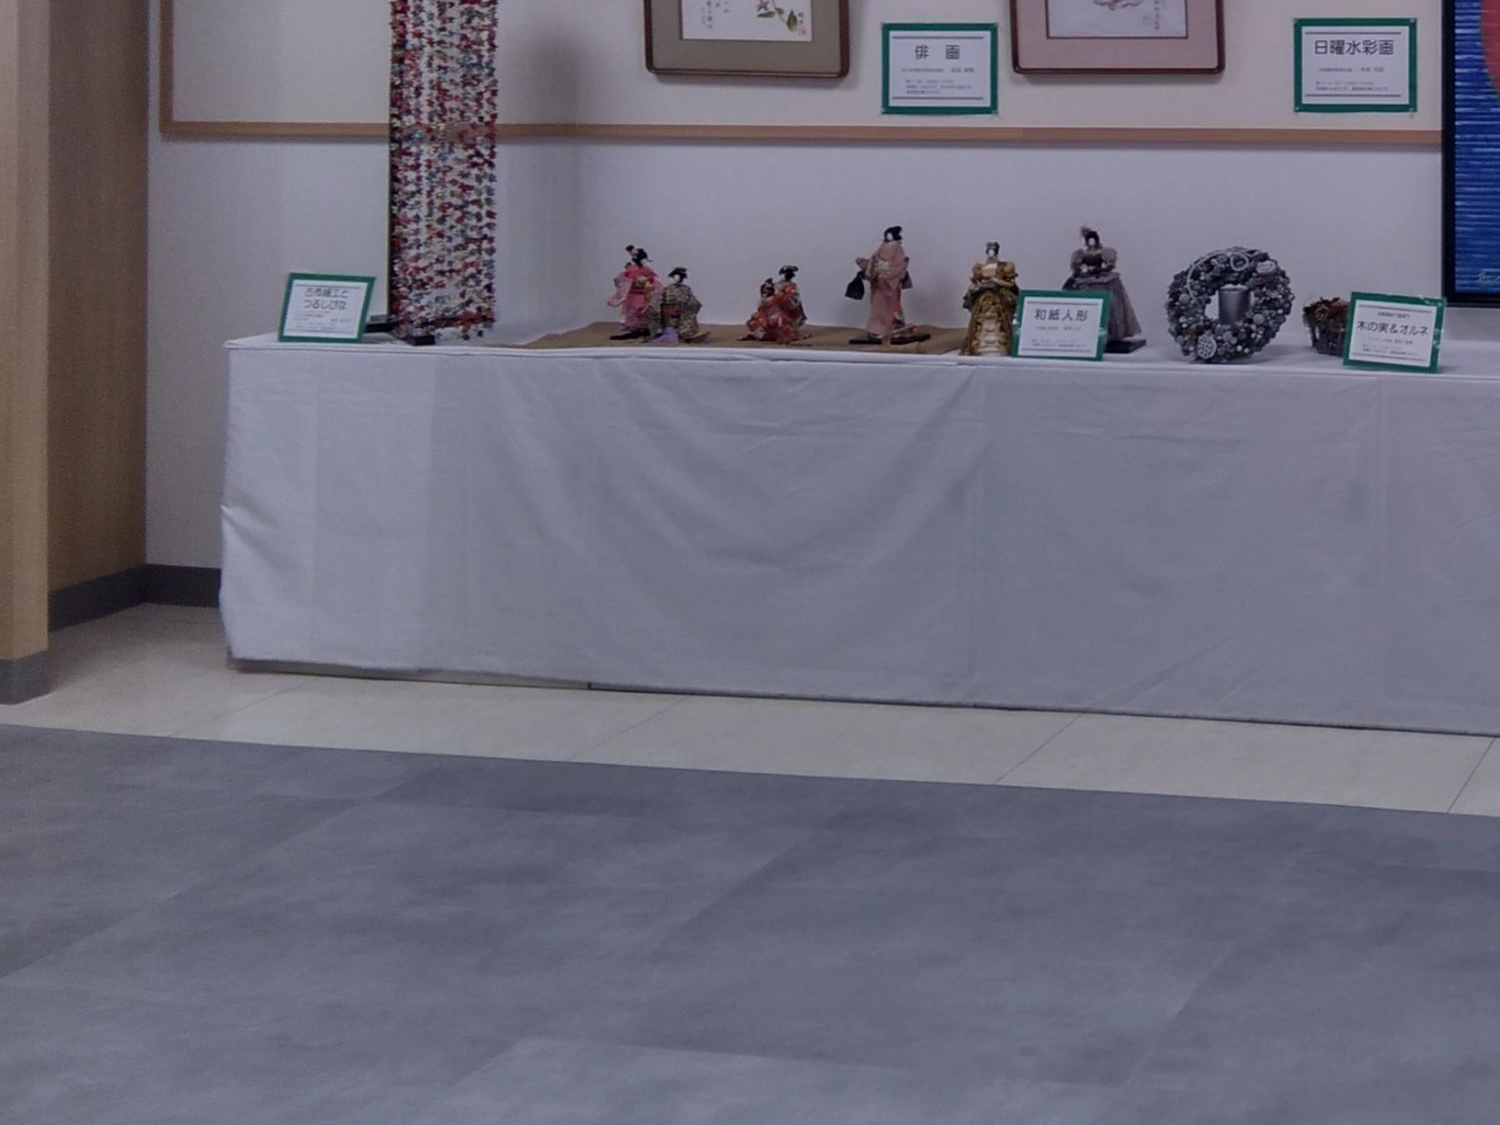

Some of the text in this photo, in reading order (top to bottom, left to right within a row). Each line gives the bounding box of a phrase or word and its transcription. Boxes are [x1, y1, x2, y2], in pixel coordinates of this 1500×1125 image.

[1315, 39, 1395, 56] 日曜水彩画
[1034, 309, 1089, 322] 和紙人形
